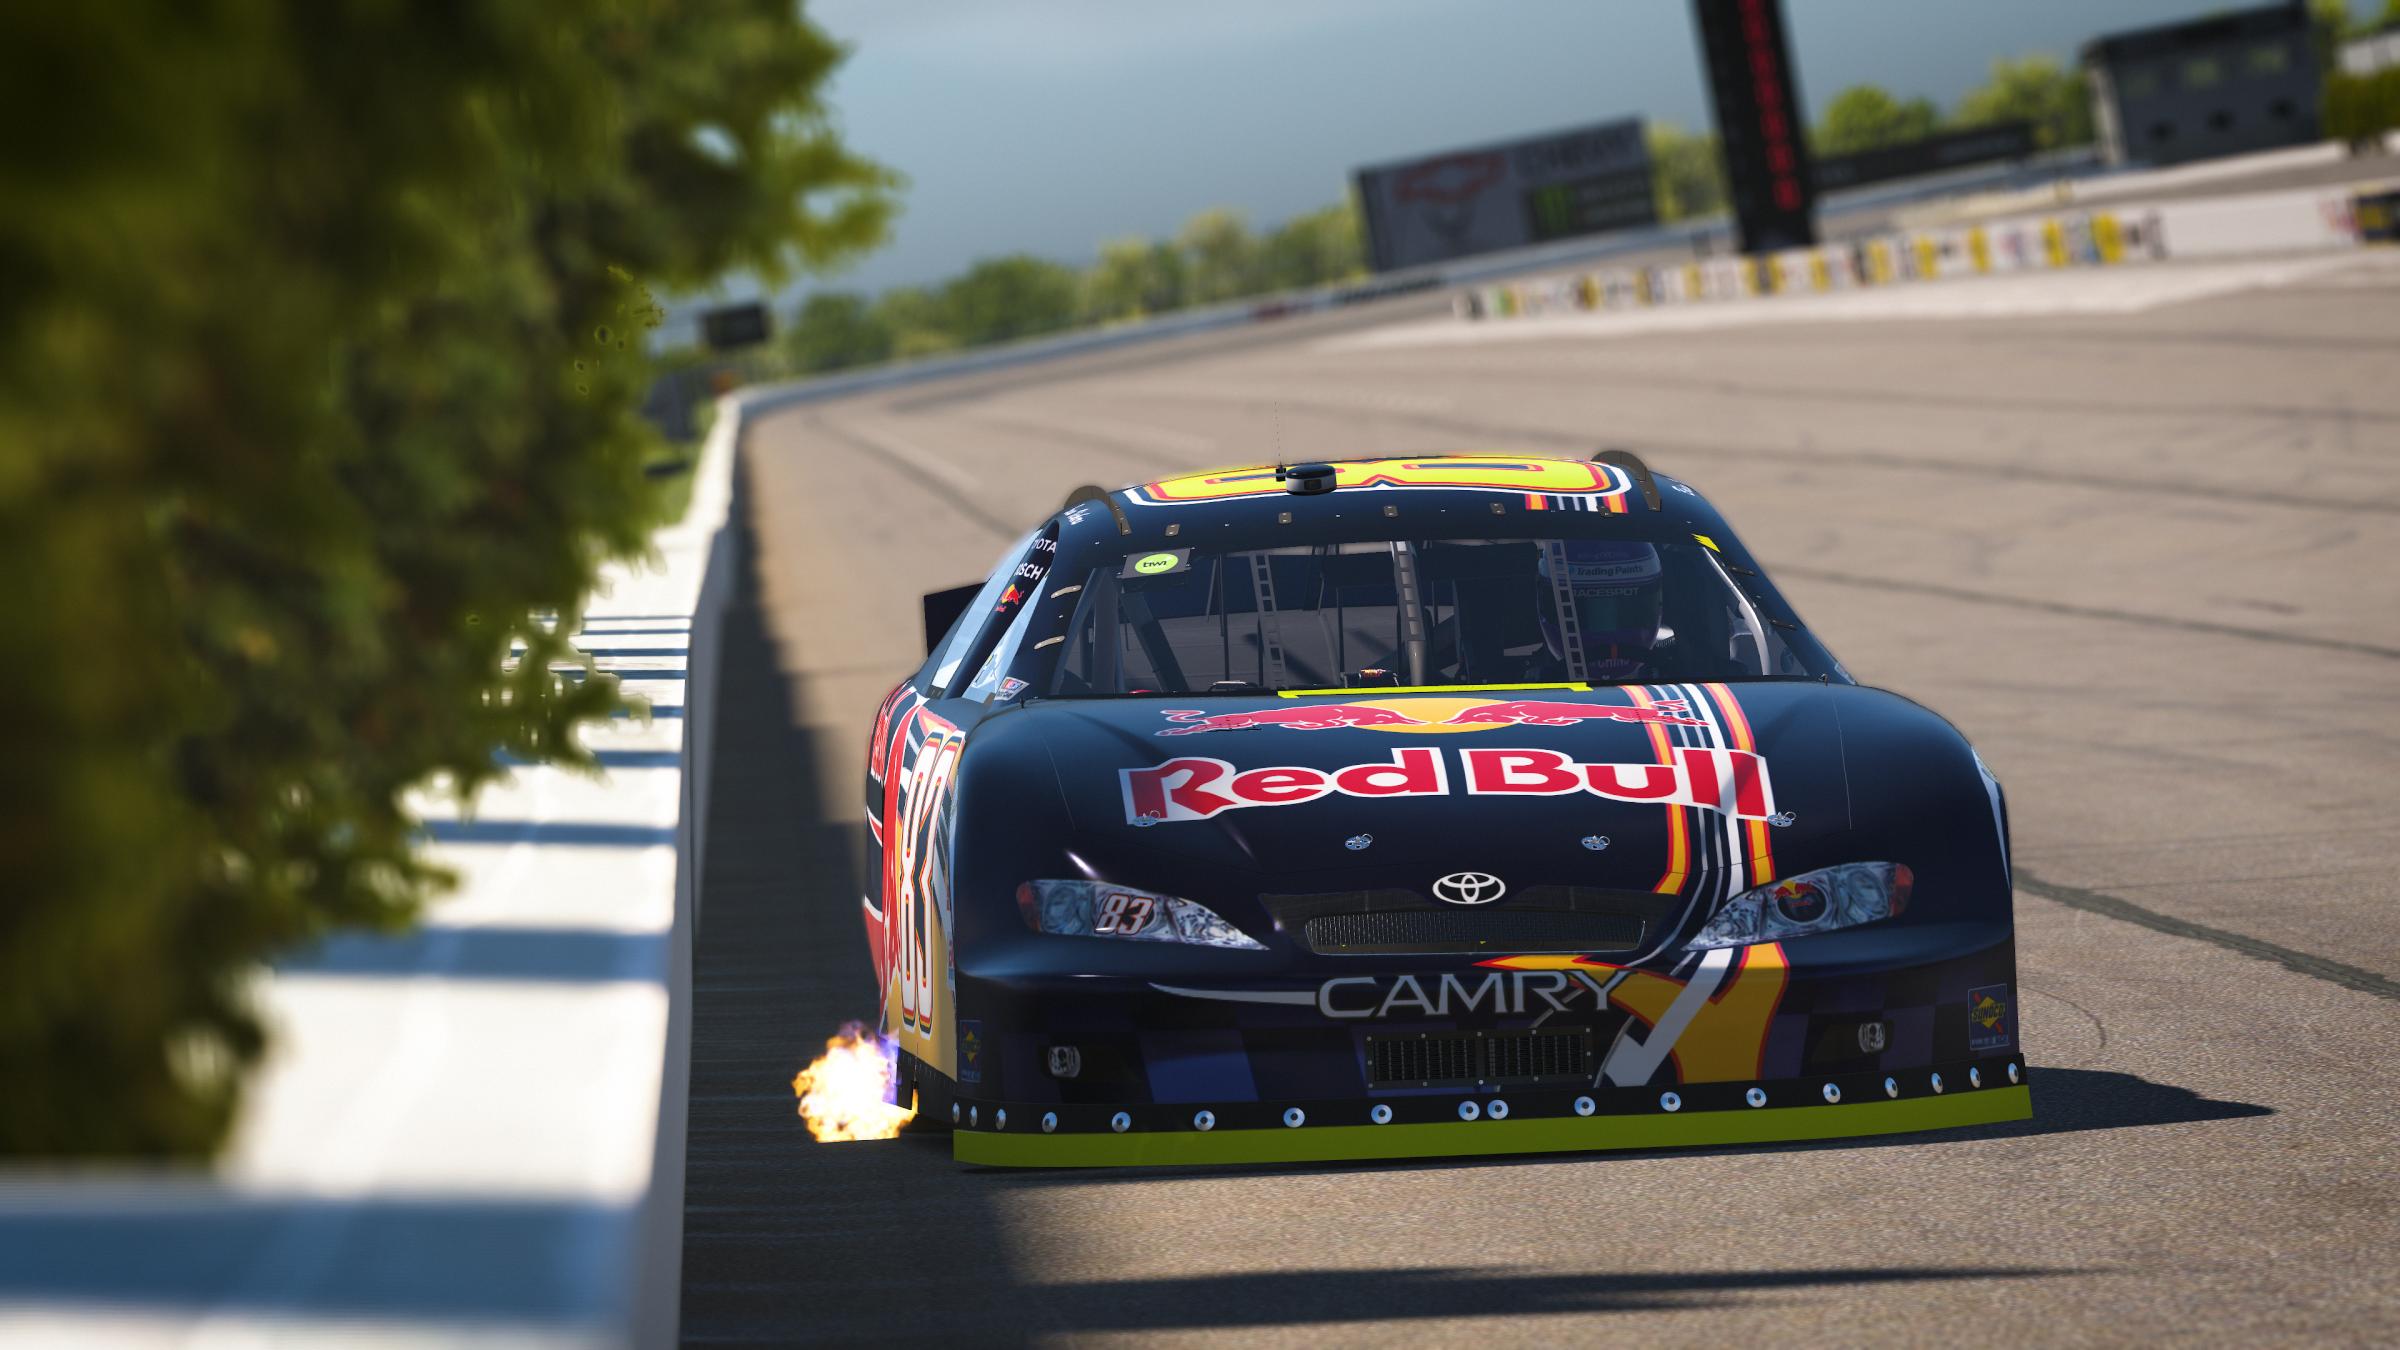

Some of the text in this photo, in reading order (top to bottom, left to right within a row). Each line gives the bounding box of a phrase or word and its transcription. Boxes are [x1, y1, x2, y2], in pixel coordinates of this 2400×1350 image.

[1577, 564, 1644, 577] Trading Paints
[1122, 746, 1774, 824] Red Bull
[899, 728, 966, 1040] 83
[1095, 892, 1154, 936] 83
[1318, 969, 1635, 1018] CAMRY
[1971, 1003, 2006, 1023] SUNOCO
